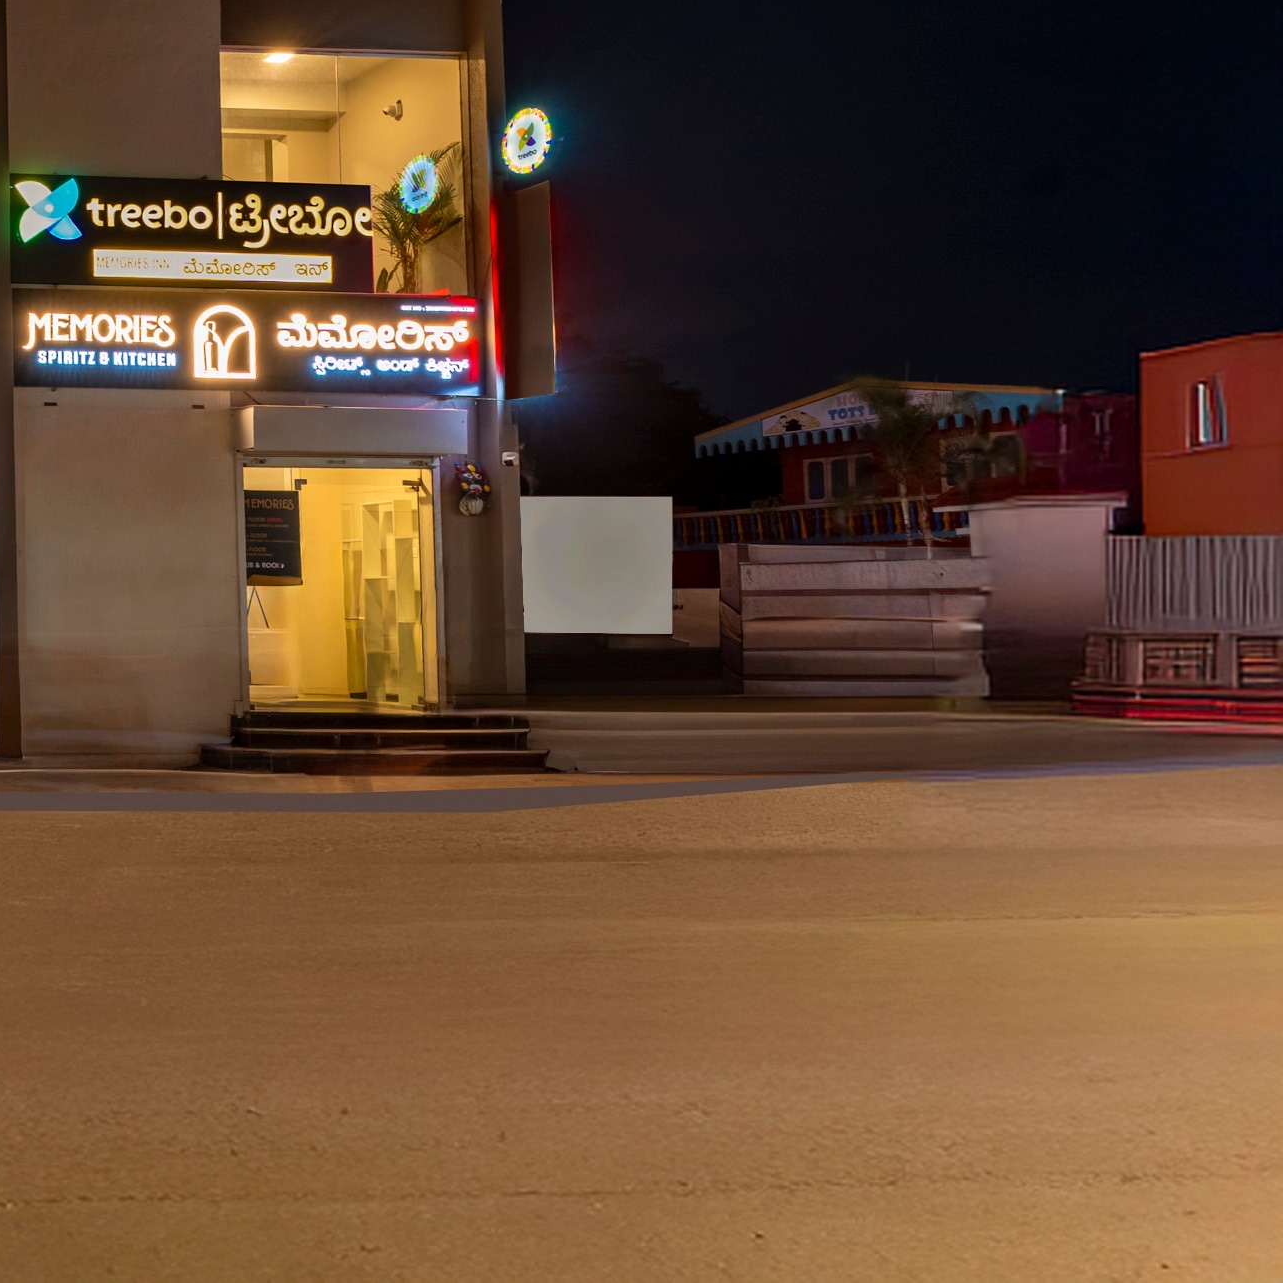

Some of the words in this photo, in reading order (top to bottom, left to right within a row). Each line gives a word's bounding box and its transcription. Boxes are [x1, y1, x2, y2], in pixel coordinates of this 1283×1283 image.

[517, 149, 537, 160] treebo
[86, 197, 214, 230] treebo
[183, 257, 277, 276] ಮೆಮೋರಿಸ್
[294, 260, 329, 277] ಇನ್
[22, 313, 176, 350] MEMORIES
[276, 313, 470, 352] ಮೆಮೋರಿಸ್
[38, 351, 96, 365] SPIRITZ
[99, 352, 110, 365] &
[113, 352, 177, 367] KITCHEN
[828, 405, 865, 421] TOTS
